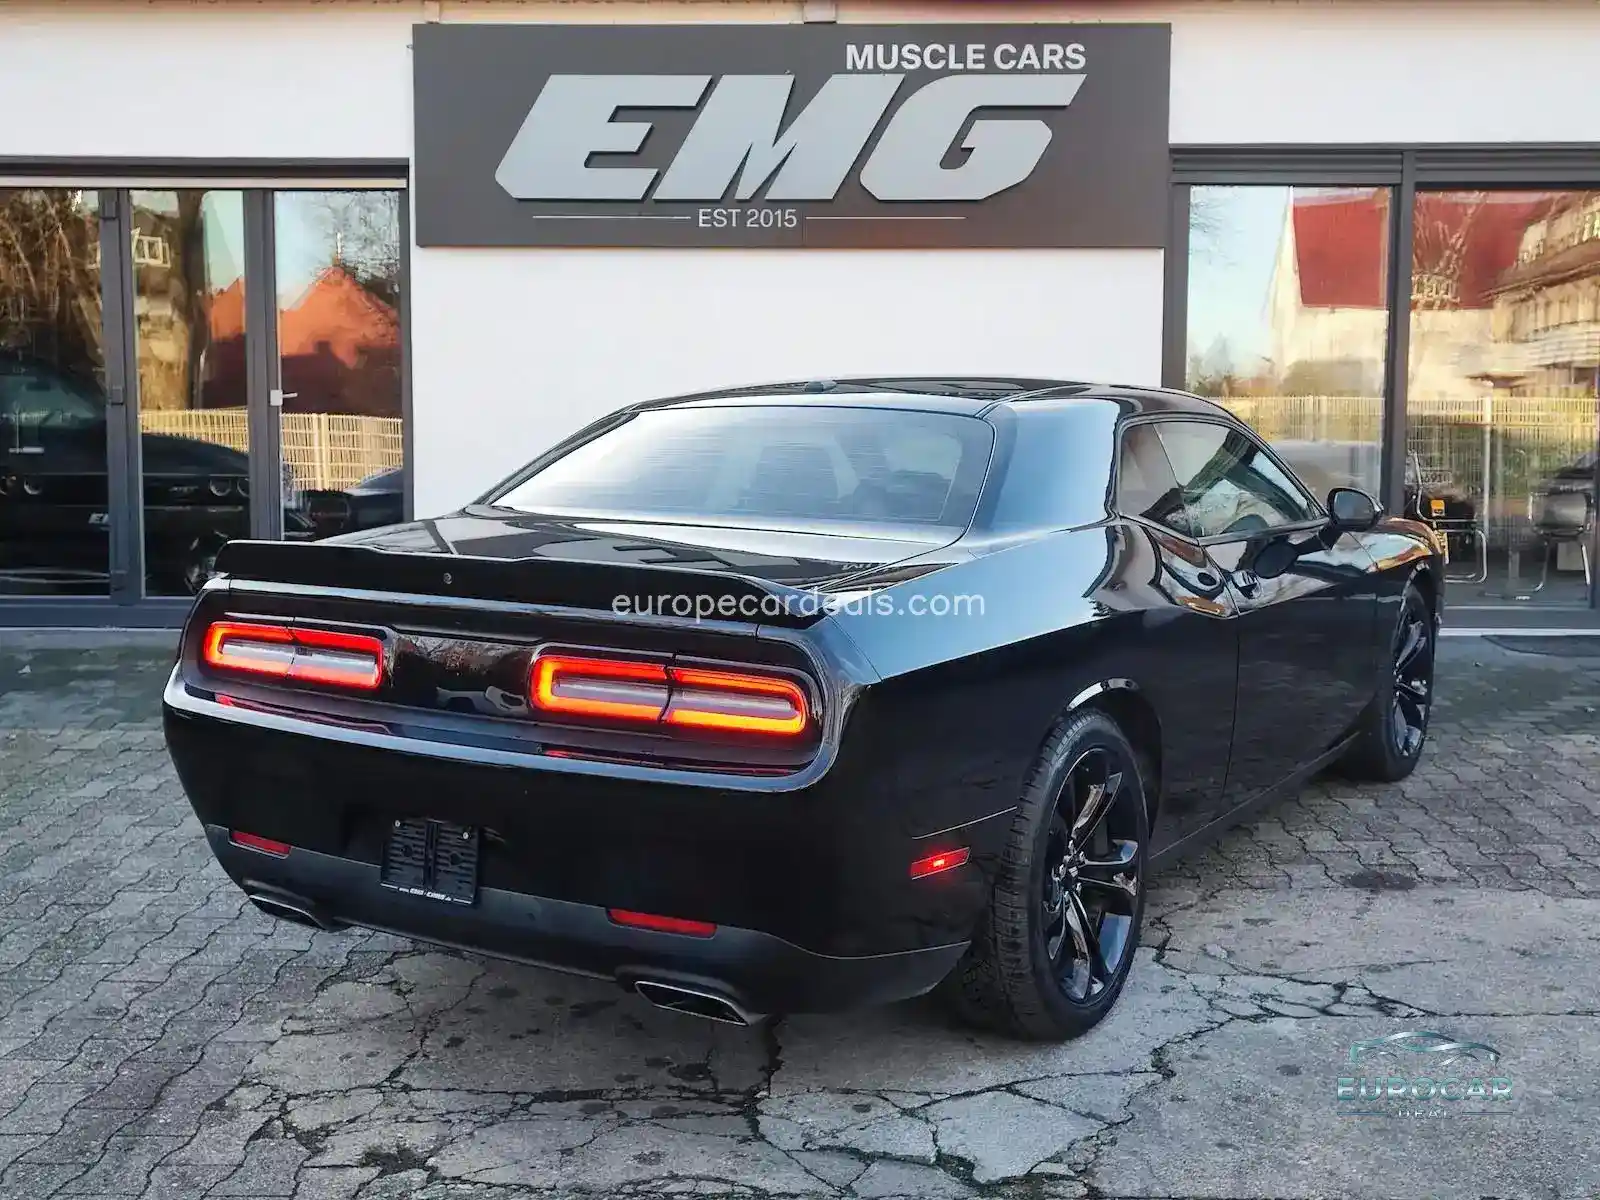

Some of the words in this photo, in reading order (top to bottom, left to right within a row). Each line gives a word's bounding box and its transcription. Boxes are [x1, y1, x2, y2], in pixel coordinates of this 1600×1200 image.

[845, 43, 986, 70] MUSCLE
[993, 43, 1087, 70] CARS
[494, 73, 1088, 202] EMG
[697, 208, 740, 228] EST
[746, 208, 798, 228] 2015
